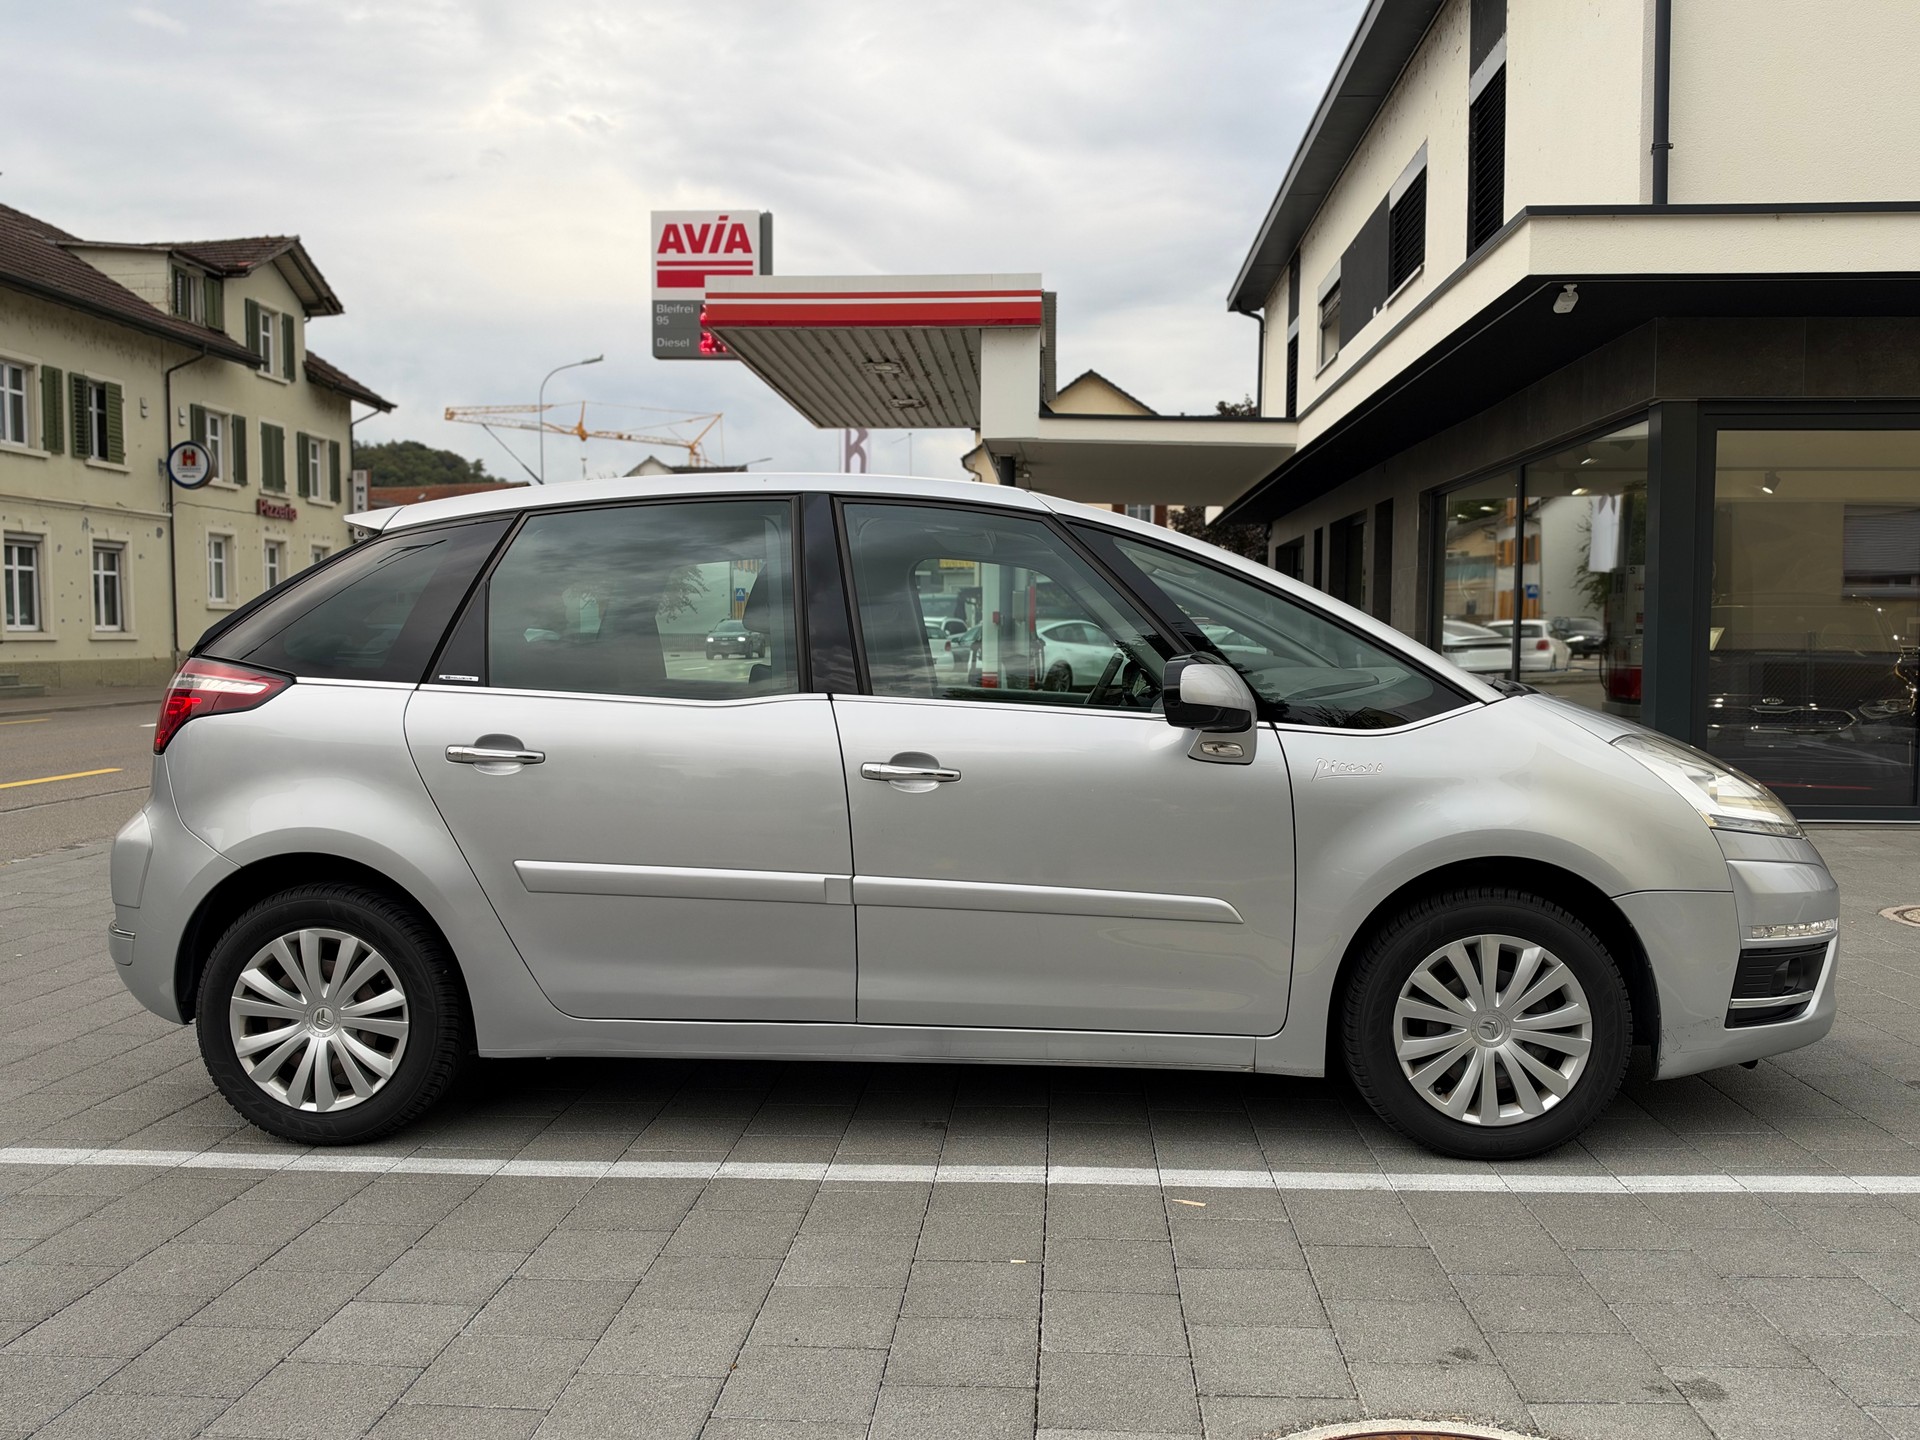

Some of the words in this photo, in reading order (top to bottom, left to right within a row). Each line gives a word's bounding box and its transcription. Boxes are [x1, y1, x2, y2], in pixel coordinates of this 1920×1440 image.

[656, 304, 694, 314] Bleifrei
[656, 316, 669, 325] 95
[656, 337, 690, 348] Diesel
[257, 499, 297, 520] Pizzeria
[1311, 757, 1384, 782] Picasso
